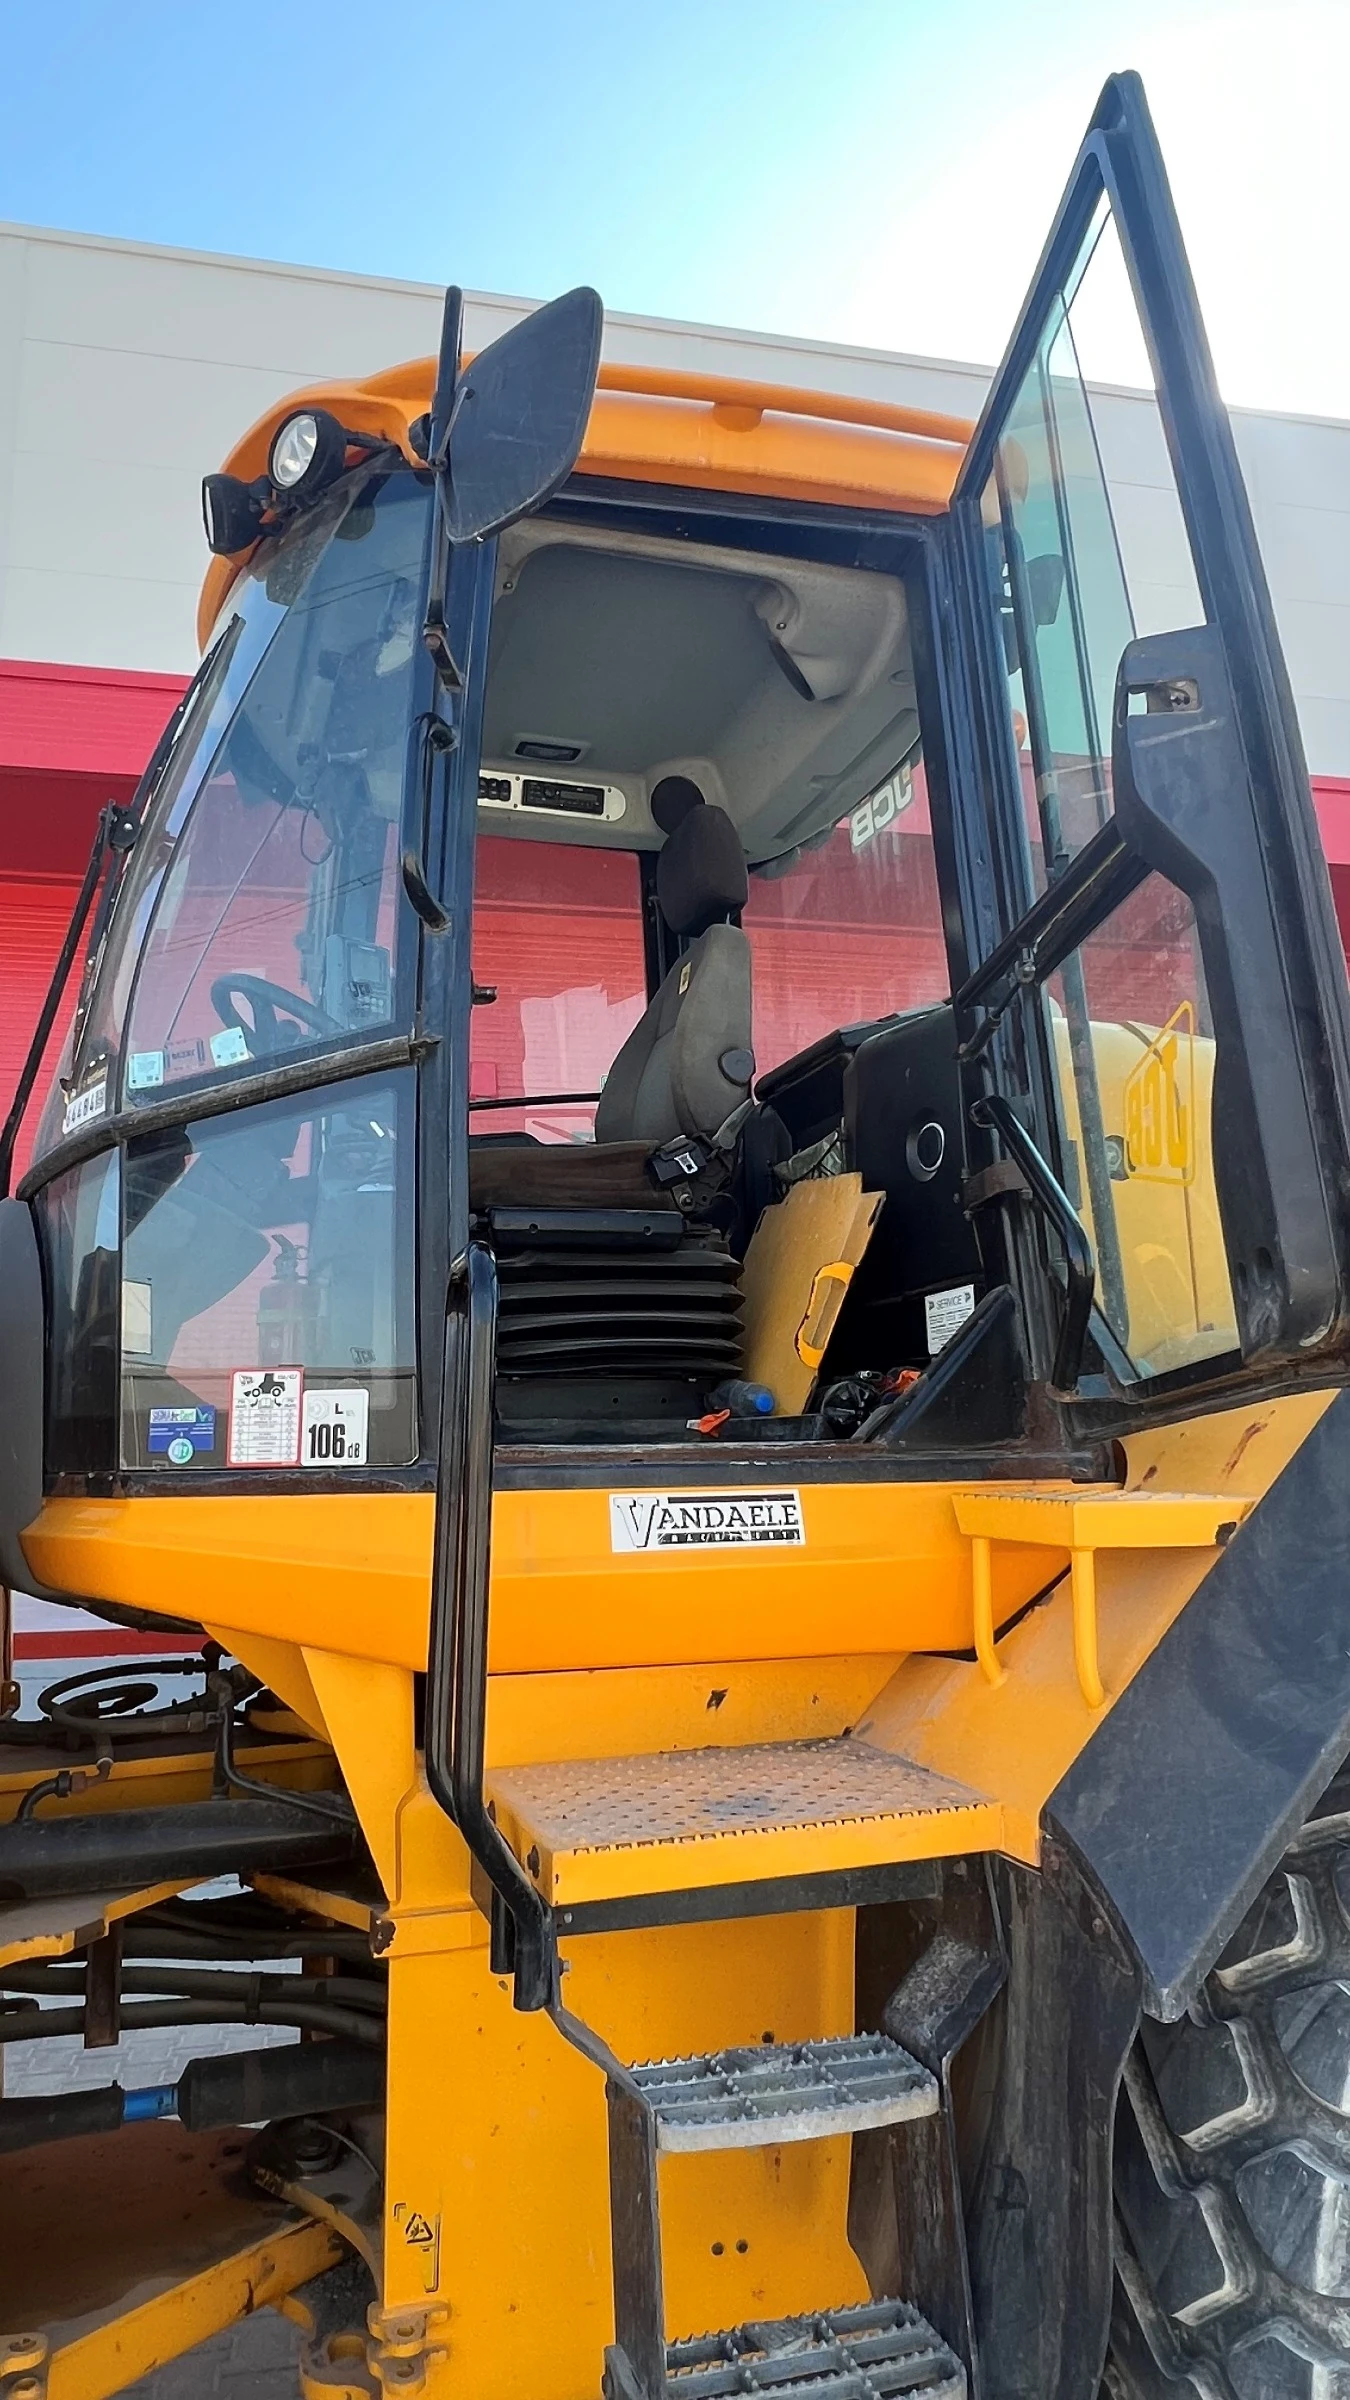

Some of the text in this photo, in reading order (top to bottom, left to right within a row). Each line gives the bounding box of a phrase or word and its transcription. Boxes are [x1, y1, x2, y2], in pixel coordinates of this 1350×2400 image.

[935, 1294, 962, 1310] SERVICE
[334, 1402, 344, 1415] L
[308, 1423, 346, 1459] 106
[347, 1442, 361, 1459] dB
[613, 1495, 799, 1548] VANDAELE
